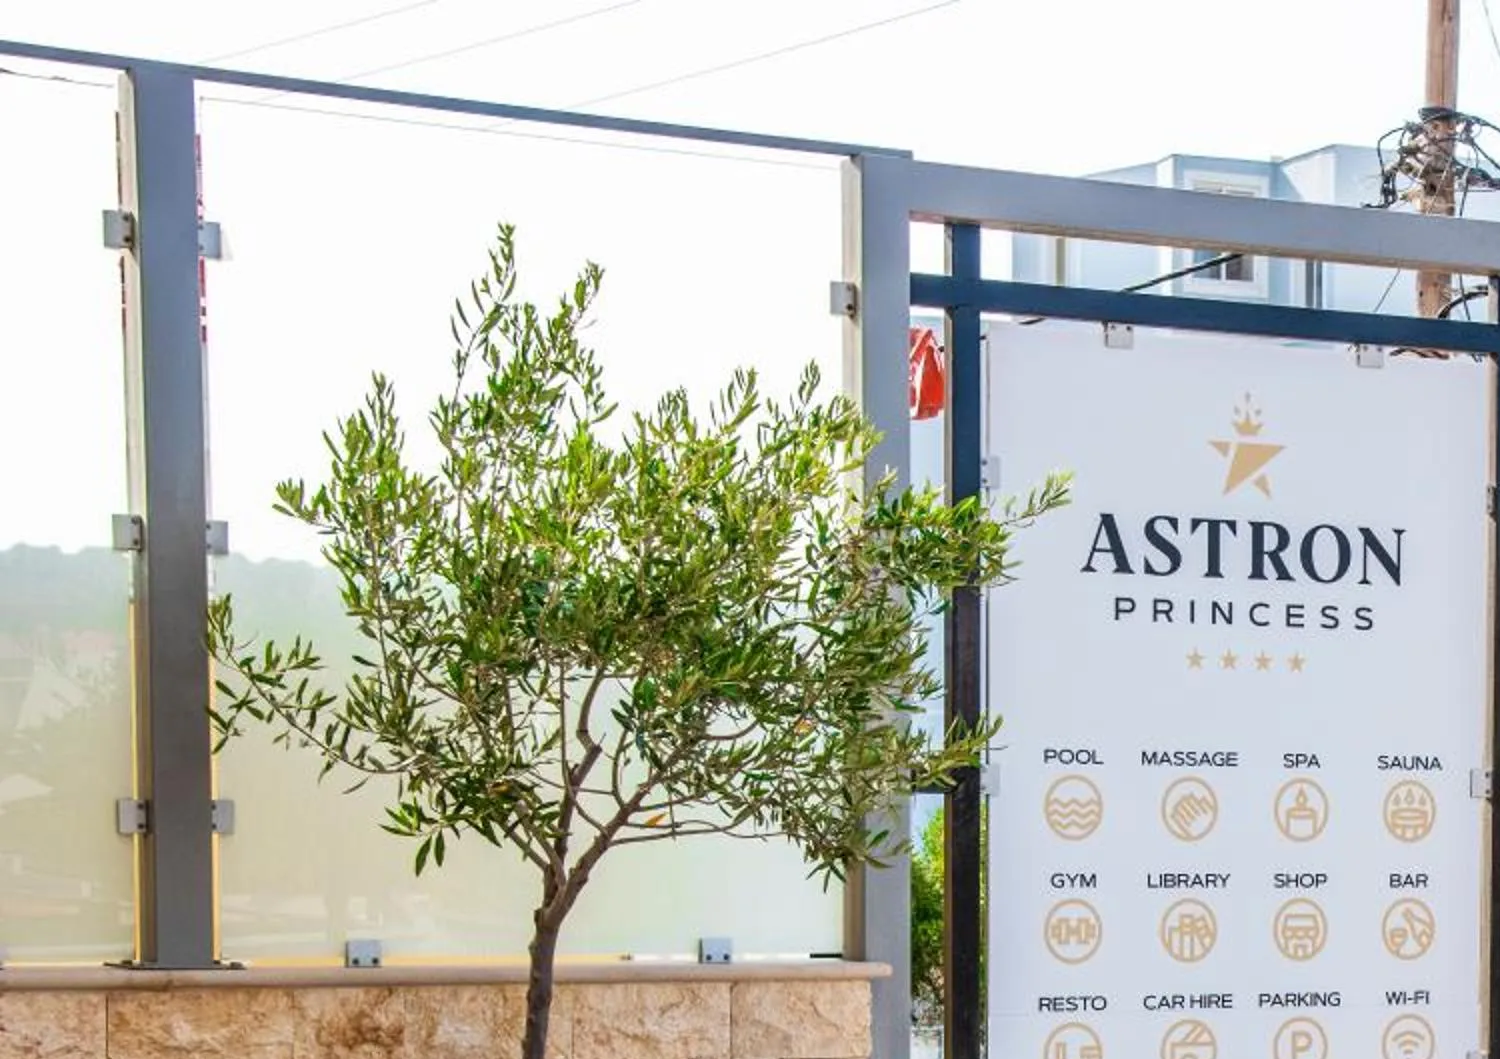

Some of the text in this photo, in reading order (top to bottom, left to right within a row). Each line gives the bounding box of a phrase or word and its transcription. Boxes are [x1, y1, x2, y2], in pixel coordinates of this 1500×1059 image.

[1080, 512, 1407, 587] ASTRON
[1114, 597, 1374, 631] PRINCESS
[1043, 748, 1104, 766] POOL
[1140, 751, 1239, 768] MASSAGE
[1283, 753, 1321, 769] SPA
[1377, 755, 1443, 771] SAUNA
[1050, 873, 1097, 889] GYM
[1146, 873, 1231, 889] LIBRARY
[1273, 873, 1328, 889] SHOP
[1389, 873, 1429, 889] BAR
[1038, 996, 1108, 1013] RESTO
[1143, 993, 1234, 1011] CAR HIRE
[1258, 991, 1342, 1009] PARKING
[1385, 990, 1431, 1006] WI-FI
